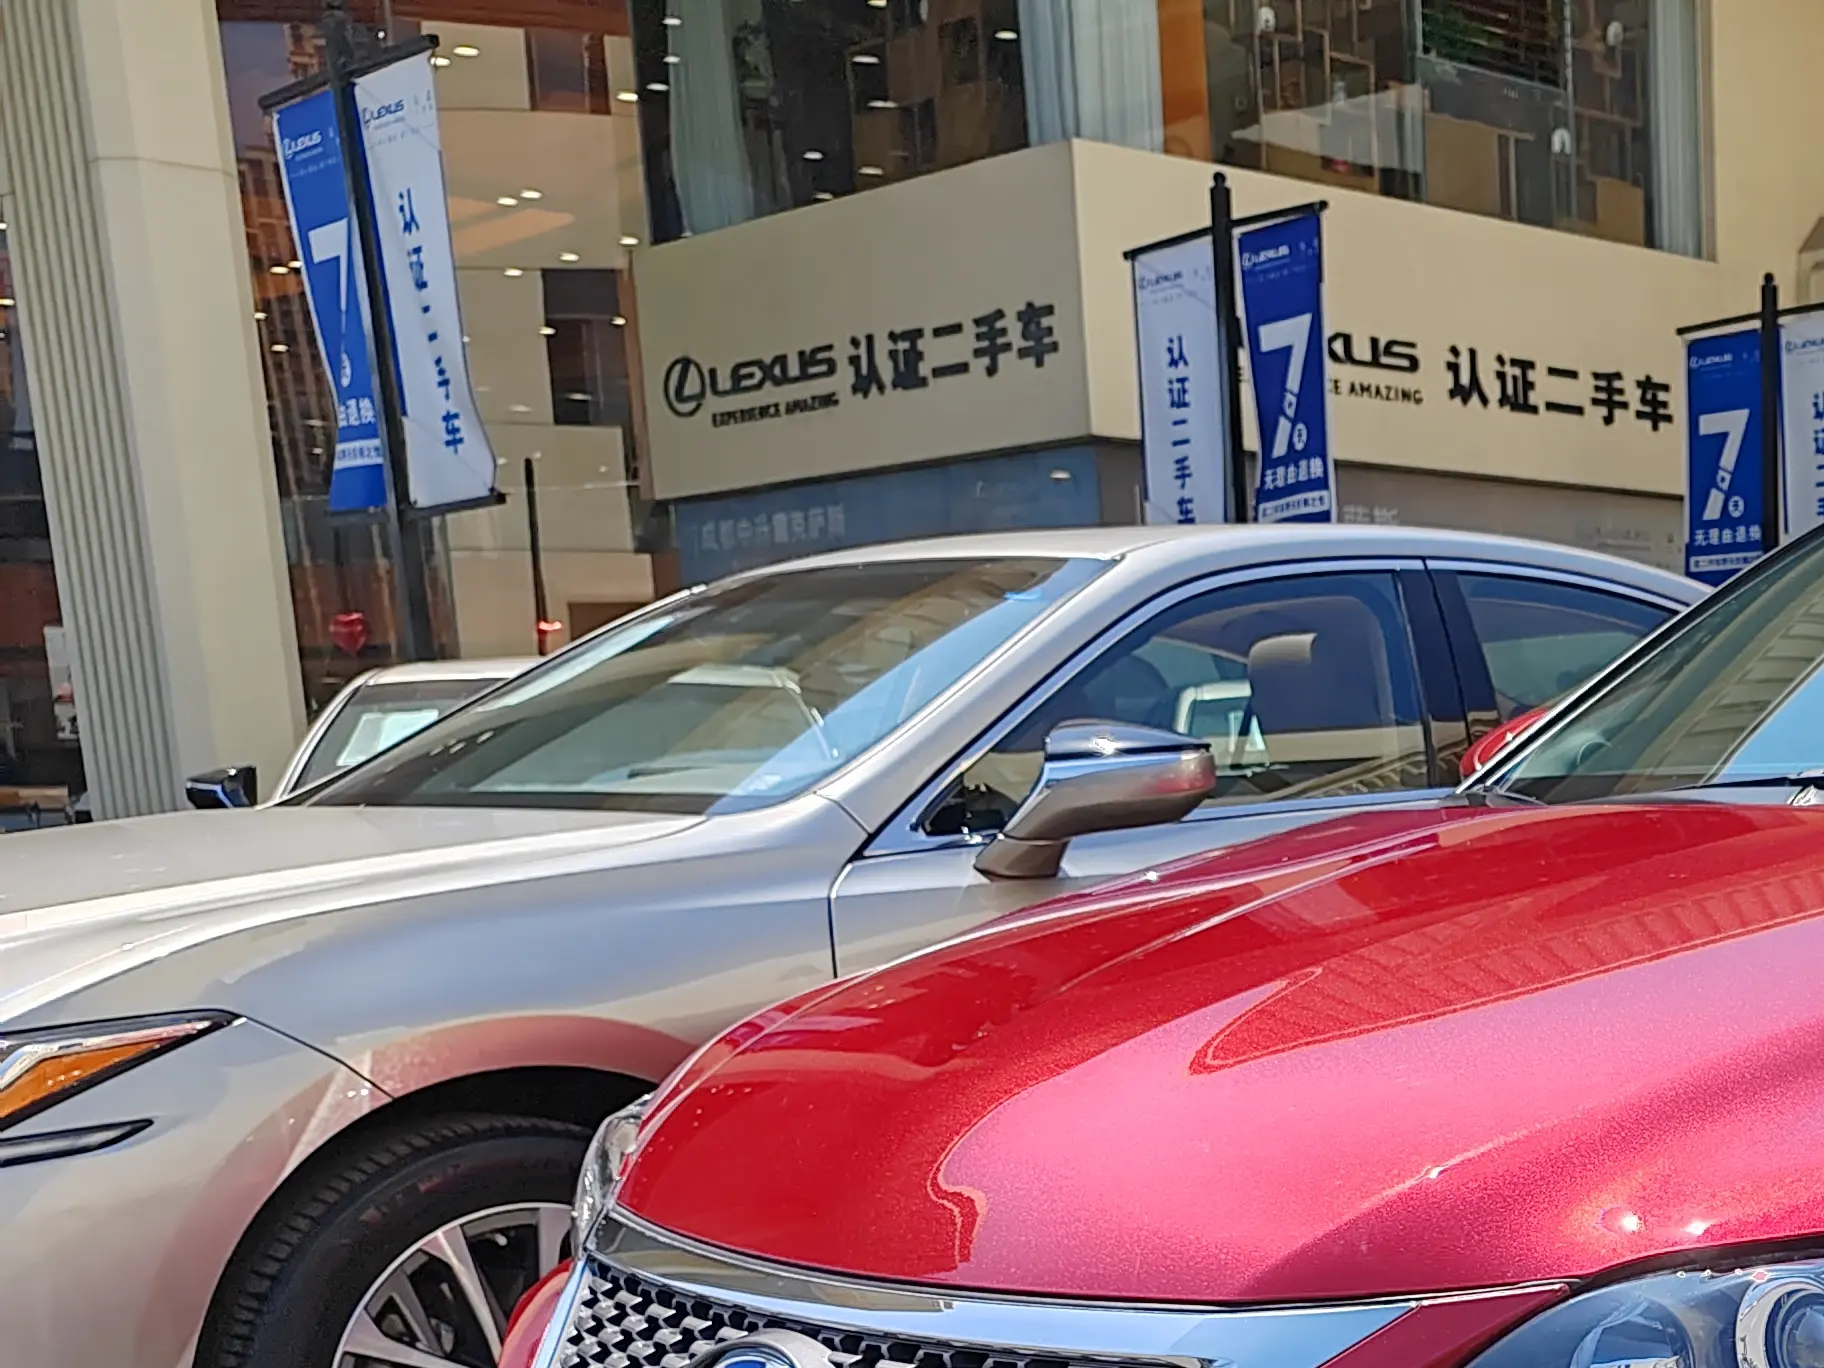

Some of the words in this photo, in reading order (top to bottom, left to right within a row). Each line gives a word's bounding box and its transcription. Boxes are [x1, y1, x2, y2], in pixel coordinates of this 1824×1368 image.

[708, 344, 837, 397] LEXUS
[848, 301, 1060, 399] 认证二手车
[1348, 381, 1424, 404] AMAZING
[1445, 345, 1674, 432] 认证二手车
[1166, 335, 1196, 524] 认证二手车
